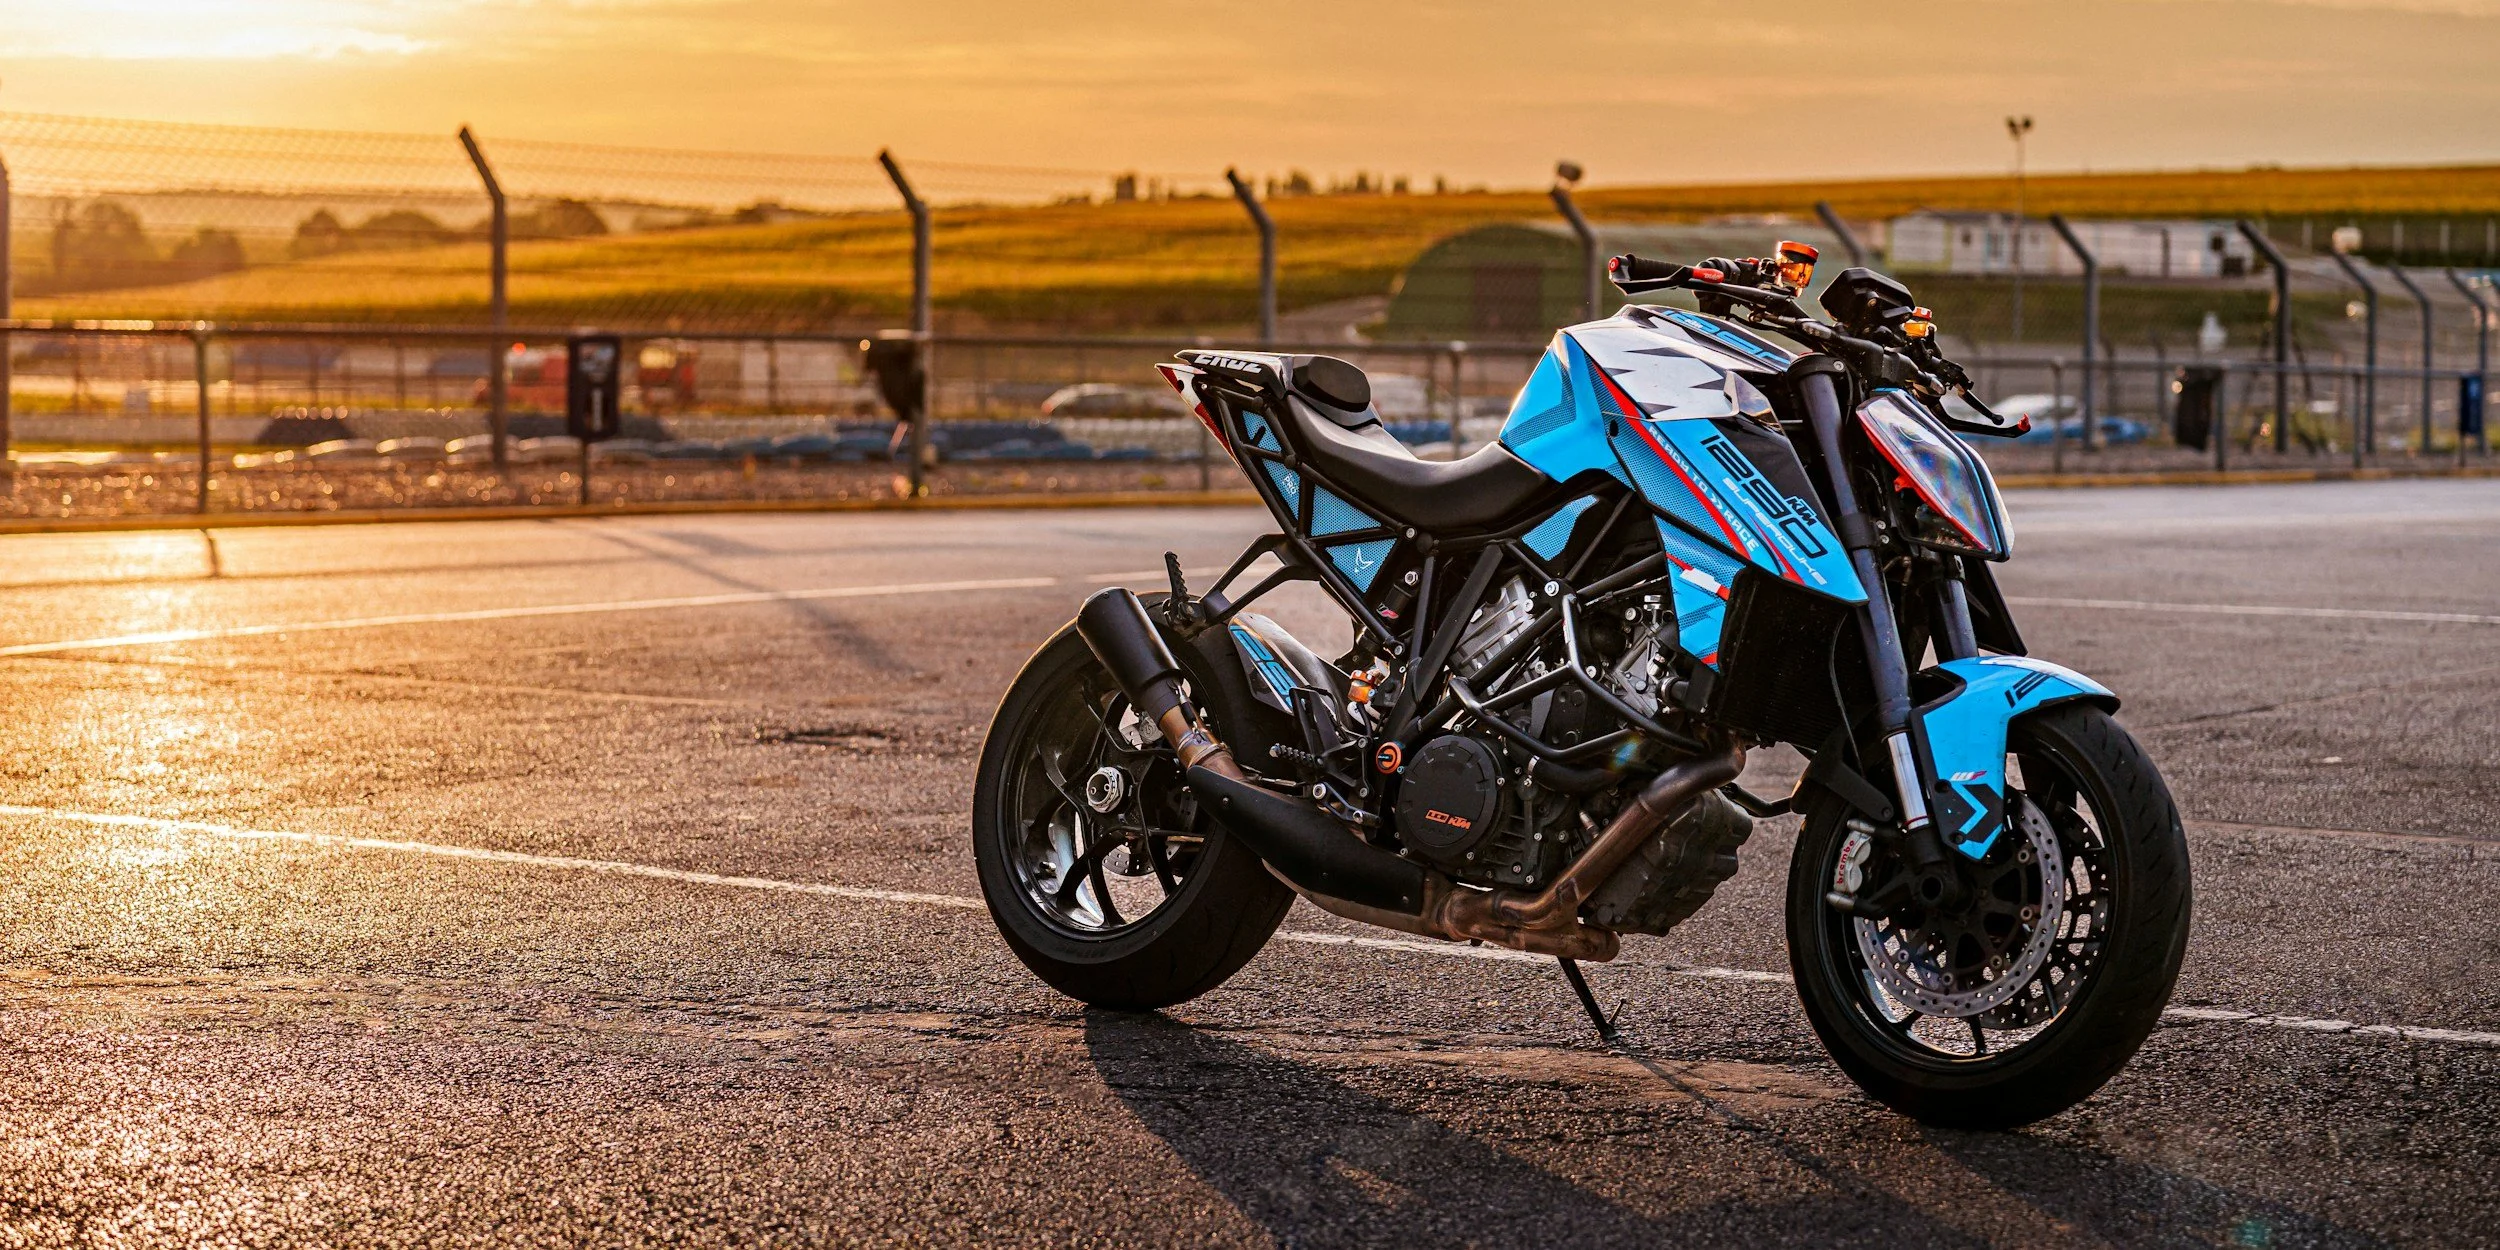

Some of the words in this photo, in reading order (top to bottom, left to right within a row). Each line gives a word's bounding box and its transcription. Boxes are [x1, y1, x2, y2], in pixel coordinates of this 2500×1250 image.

[1648, 425, 1690, 476] READY
[1691, 473, 1708, 494] TO
[1723, 510, 1760, 551] RACE
[1700, 434, 1828, 559] 1290
[1786, 496, 1818, 527] KTM
[1448, 816, 1471, 830] KTM
[1836, 840, 1855, 884] brembo
